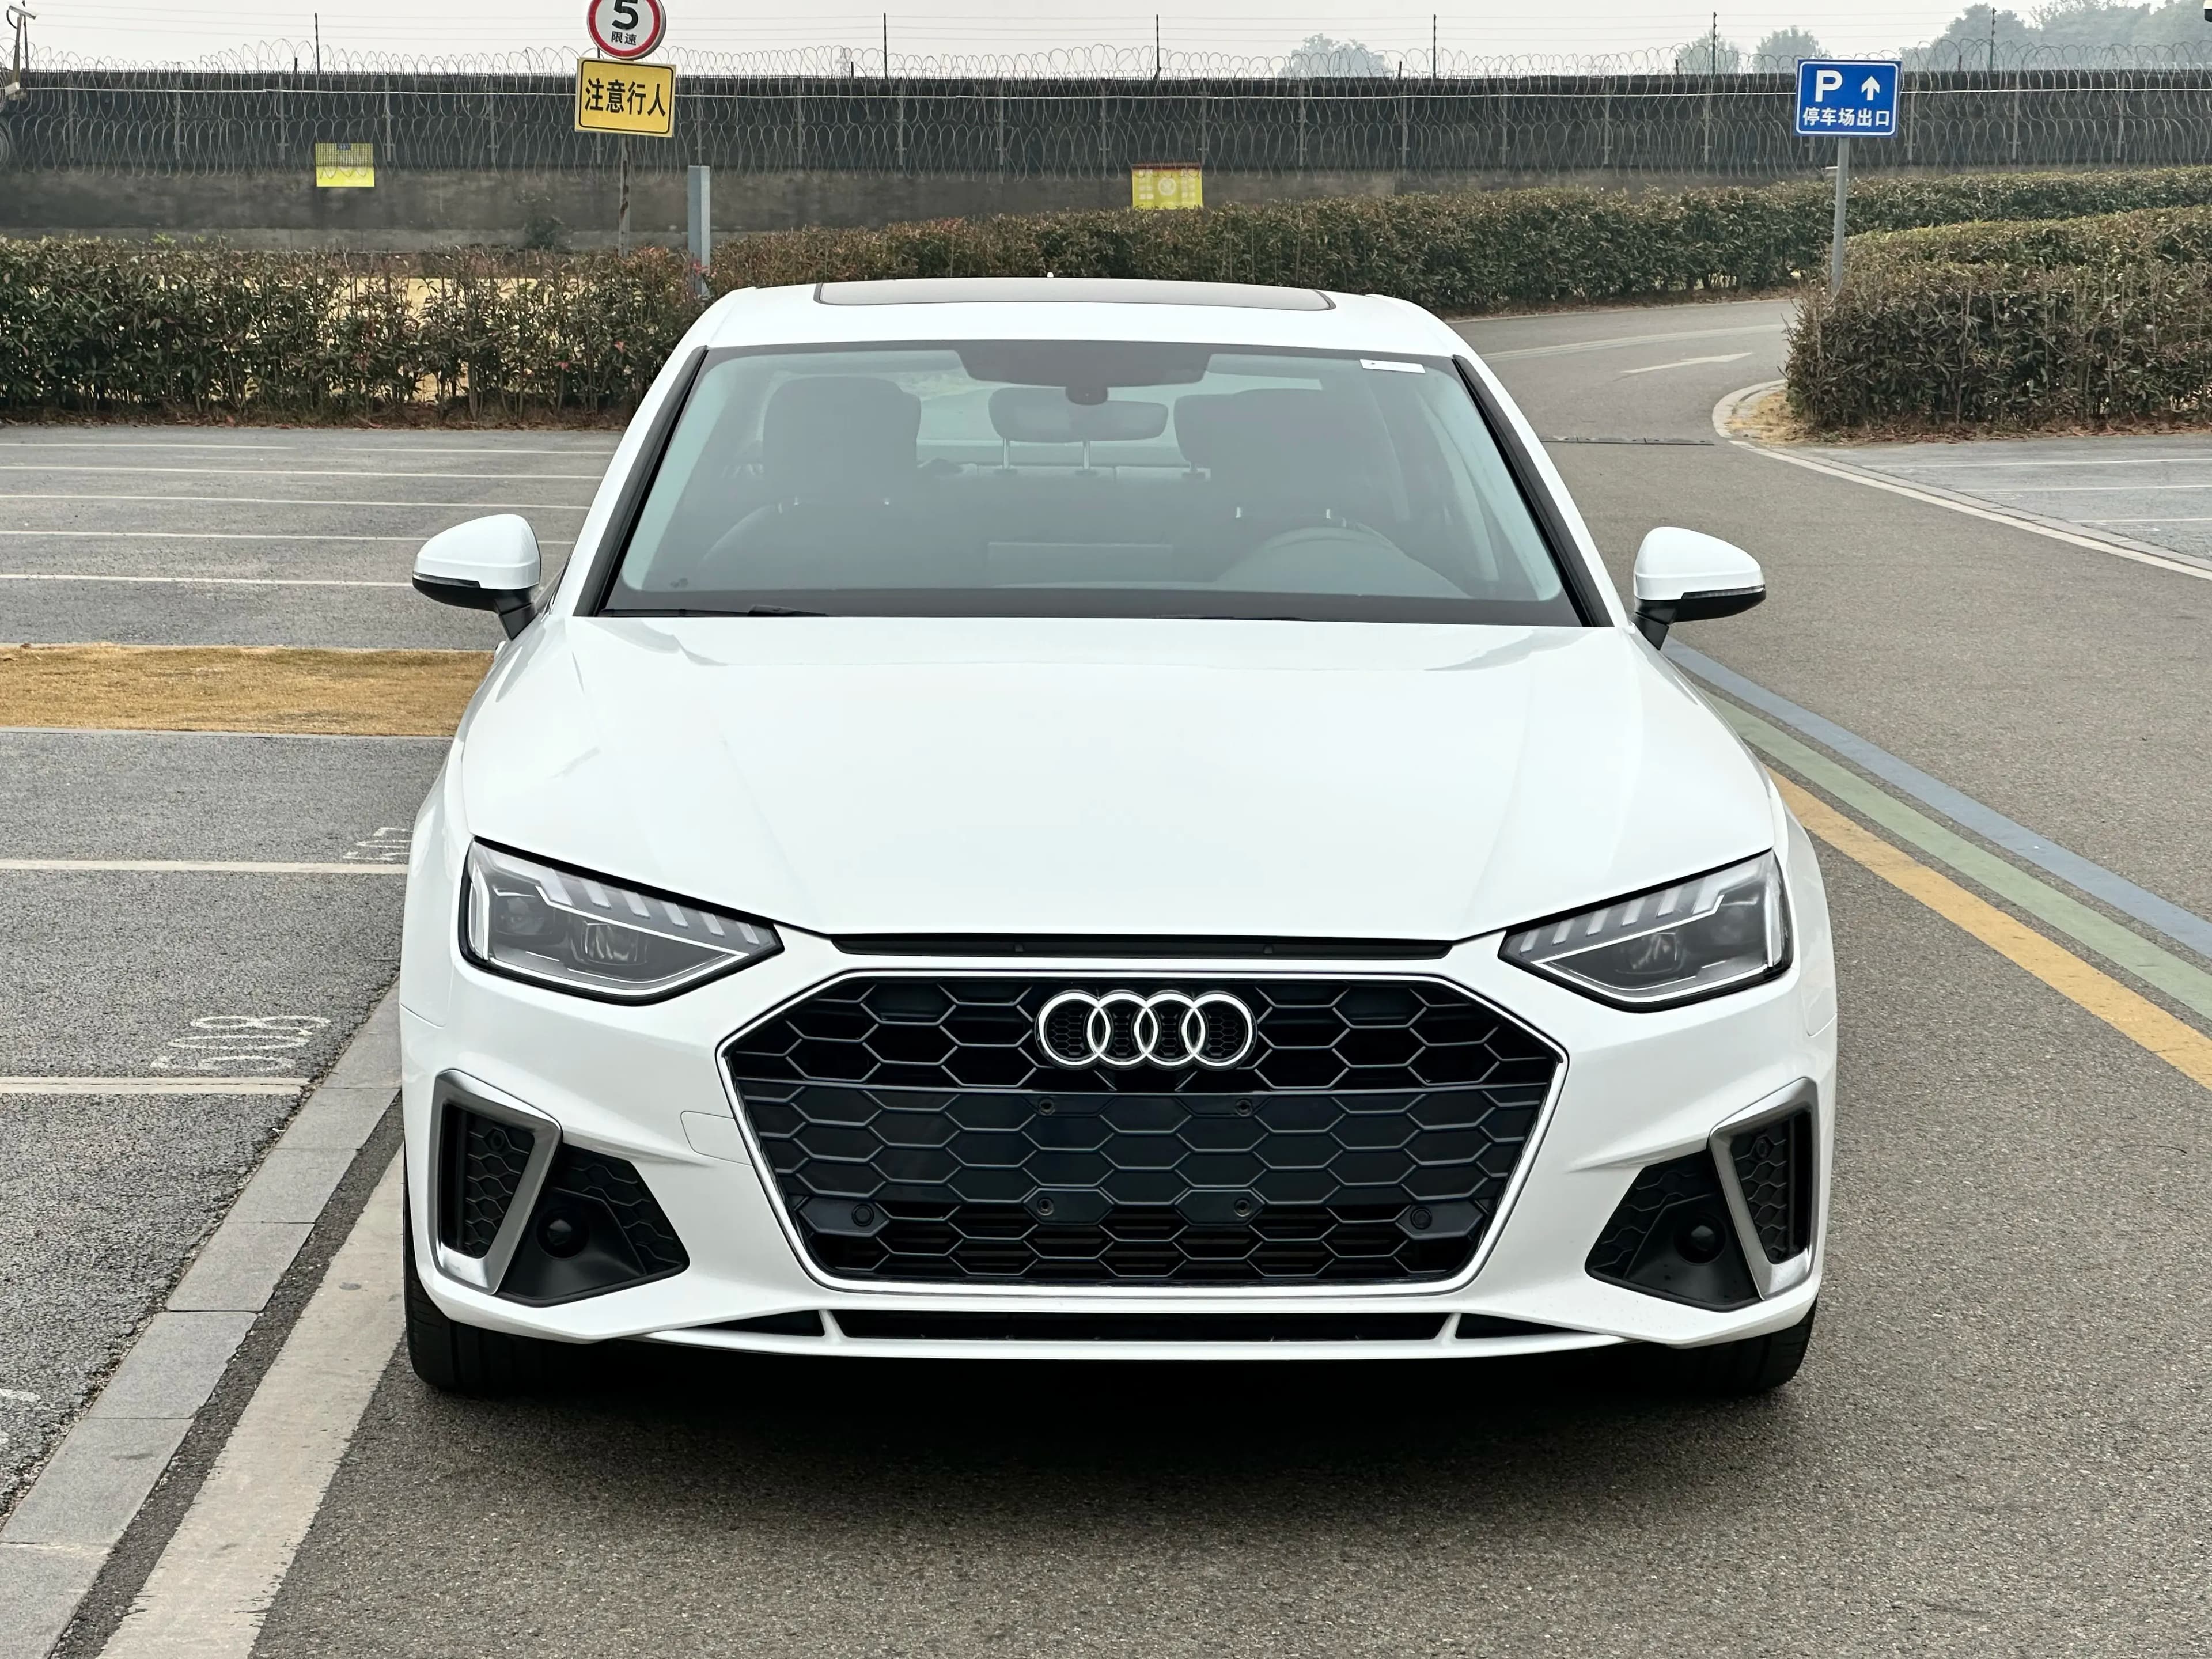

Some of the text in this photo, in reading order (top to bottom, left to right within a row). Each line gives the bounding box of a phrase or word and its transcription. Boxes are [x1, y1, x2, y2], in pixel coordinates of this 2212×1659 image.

[612, 0, 638, 30] 5
[611, 31, 637, 46] 限速
[584, 78, 666, 117] 注意行人
[1815, 70, 1843, 103] P
[1802, 107, 1890, 127] 停车场出口
